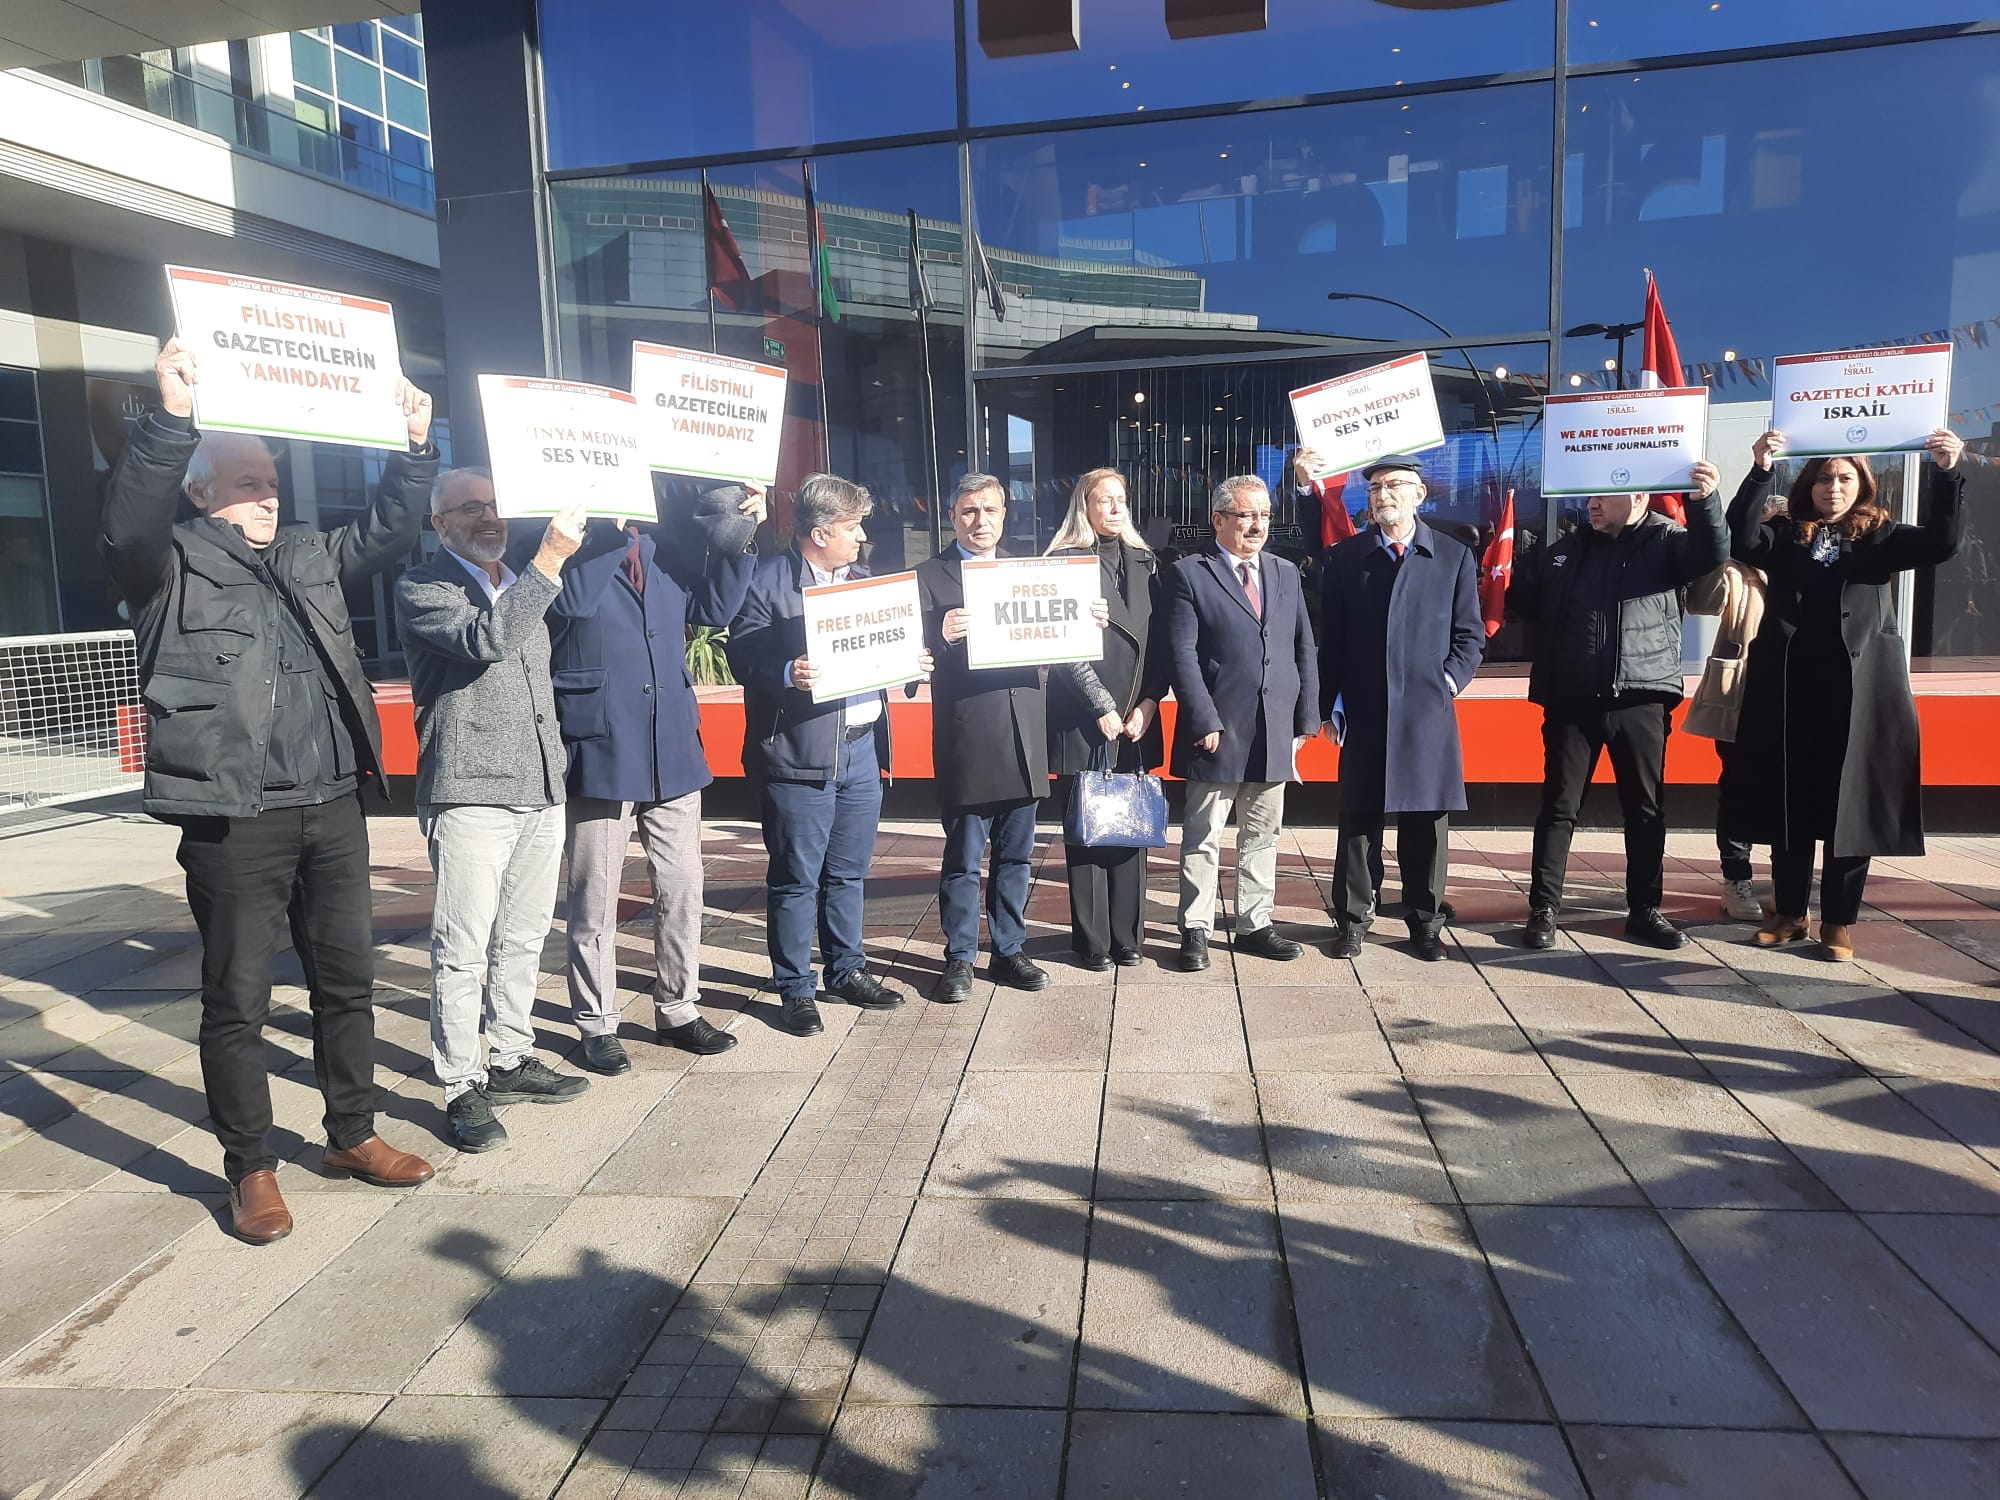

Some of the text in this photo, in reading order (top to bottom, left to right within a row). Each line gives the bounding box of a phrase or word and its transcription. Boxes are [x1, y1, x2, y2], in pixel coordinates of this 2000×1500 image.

[241, 304, 345, 338] FİLİSTİNLİ
[213, 330, 376, 370] GAZETECİLERİN
[241, 361, 361, 393] YANINDAYIZ
[680, 372, 753, 399] FİLİSTİNLİ
[1790, 378, 1934, 402] GAZETECİ KATİLİ
[655, 393, 767, 423] GAZETECİLERİN
[1312, 388, 1421, 428] DÜNYA MEDYASI
[1607, 406, 1637, 415] ISRAEL
[671, 417, 755, 442] YANINDAYIZ
[1334, 409, 1400, 437] SES VER!
[1560, 425, 1684, 439] WE ARE TOGETHER WITH
[542, 447, 575, 463] SES
[1565, 440, 1679, 452] PALESTINE JOURNALISTS
[1012, 584, 1058, 598] PRESS
[816, 615, 851, 634] FREE
[994, 598, 1078, 625] KILLER
[832, 627, 906, 654] FREE PRESS
[1010, 626, 1059, 640] ISRAEL
